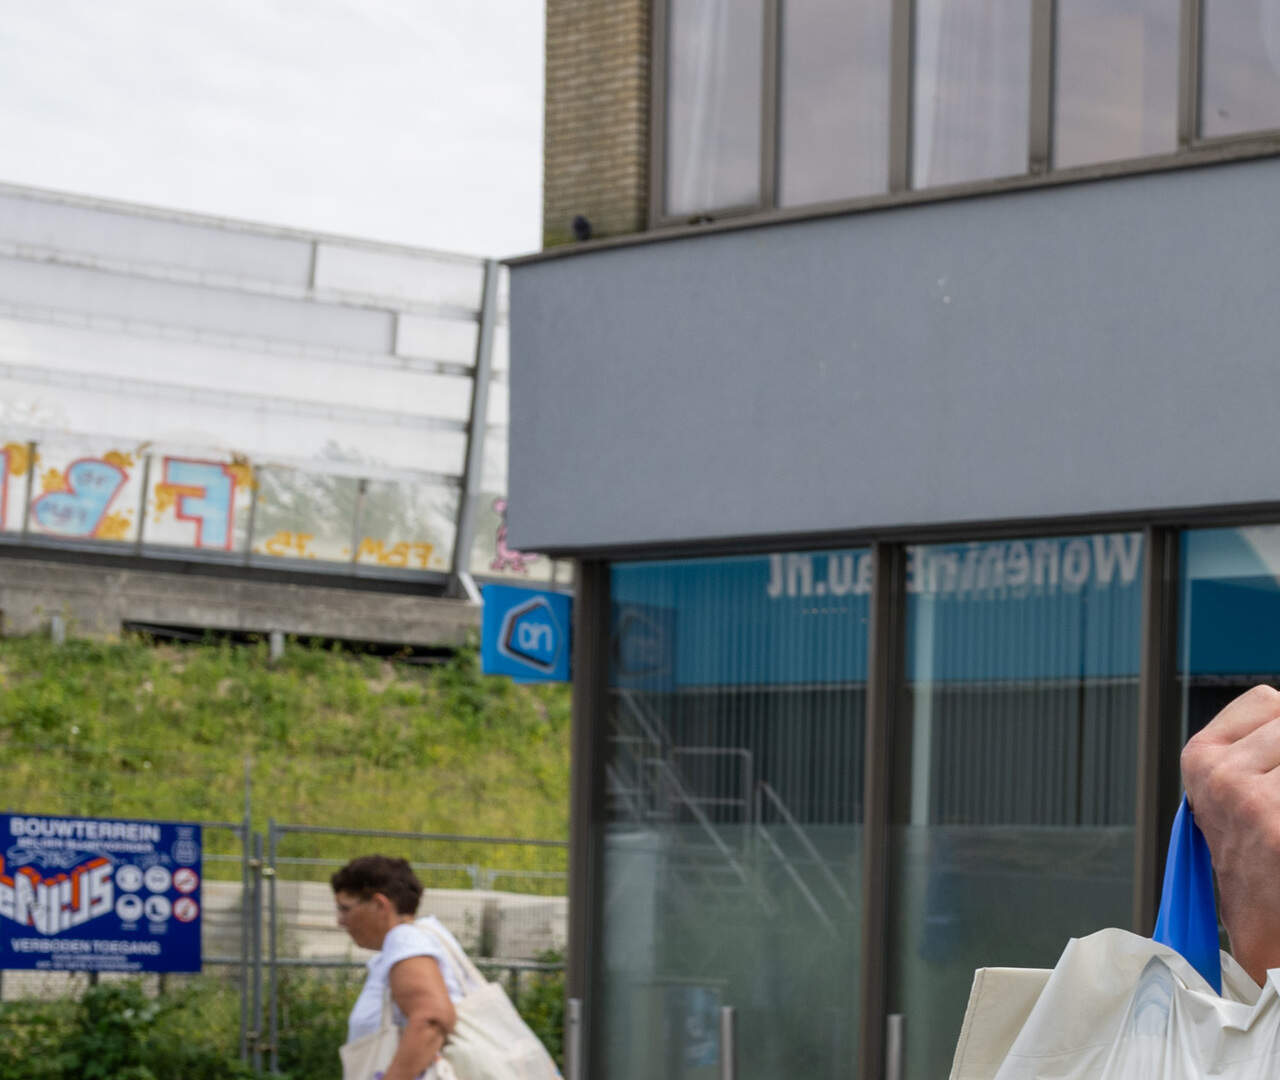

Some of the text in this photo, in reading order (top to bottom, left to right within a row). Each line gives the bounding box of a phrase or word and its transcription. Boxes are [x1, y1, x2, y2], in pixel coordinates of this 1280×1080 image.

[9, 817, 162, 843] BOUWTERREIN
[11, 937, 161, 956] VERBODEN TOEGANG
